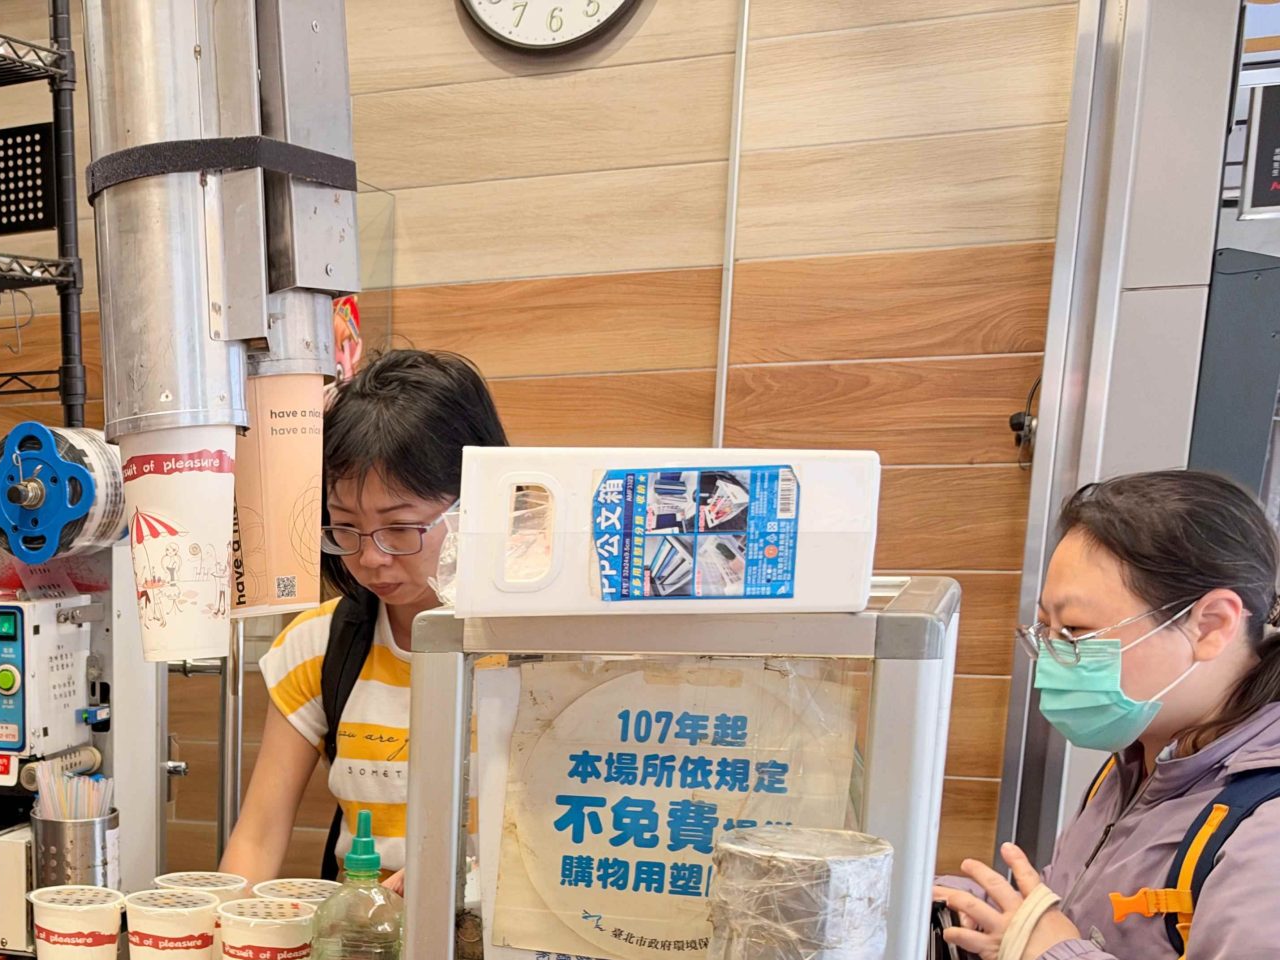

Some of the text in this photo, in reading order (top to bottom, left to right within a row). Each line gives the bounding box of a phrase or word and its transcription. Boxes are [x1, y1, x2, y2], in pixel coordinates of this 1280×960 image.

[512, 1, 528, 28] 7
[548, 7, 563, 32] 6
[270, 409, 298, 420] have
[301, 410, 307, 418] a
[270, 426, 298, 437] have
[301, 427, 307, 435] a
[143, 460, 155, 474] of
[163, 457, 220, 473] pleasure
[234, 558, 247, 606] have
[617, 709, 748, 747] 107年起
[567, 750, 789, 794] 本場所依規定
[554, 794, 792, 855] 不免費
[560, 854, 713, 897] 購物用塑
[49, 934, 93, 944] pleasure
[143, 938, 153, 946] of
[158, 939, 202, 948] pleasure
[259, 951, 270, 959] of
